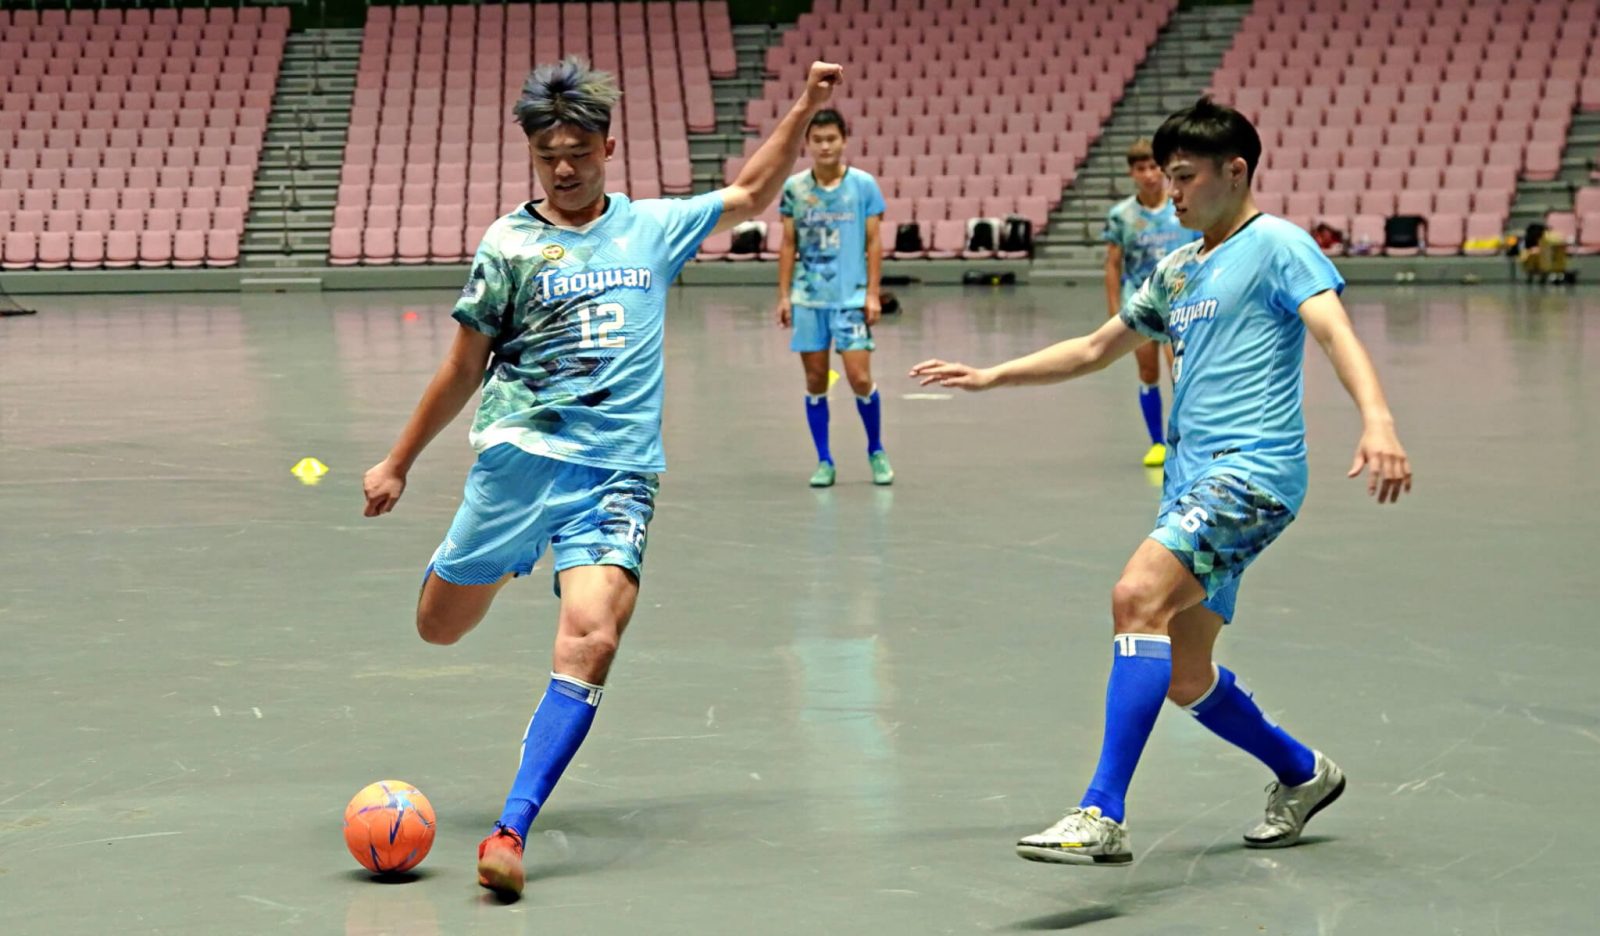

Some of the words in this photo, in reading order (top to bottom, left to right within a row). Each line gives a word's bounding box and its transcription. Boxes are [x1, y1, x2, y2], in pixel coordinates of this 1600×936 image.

[817, 227, 840, 249] 14
[536, 266, 652, 305] Taoyuan
[578, 303, 625, 348] 12
[1180, 506, 1209, 533] 6
